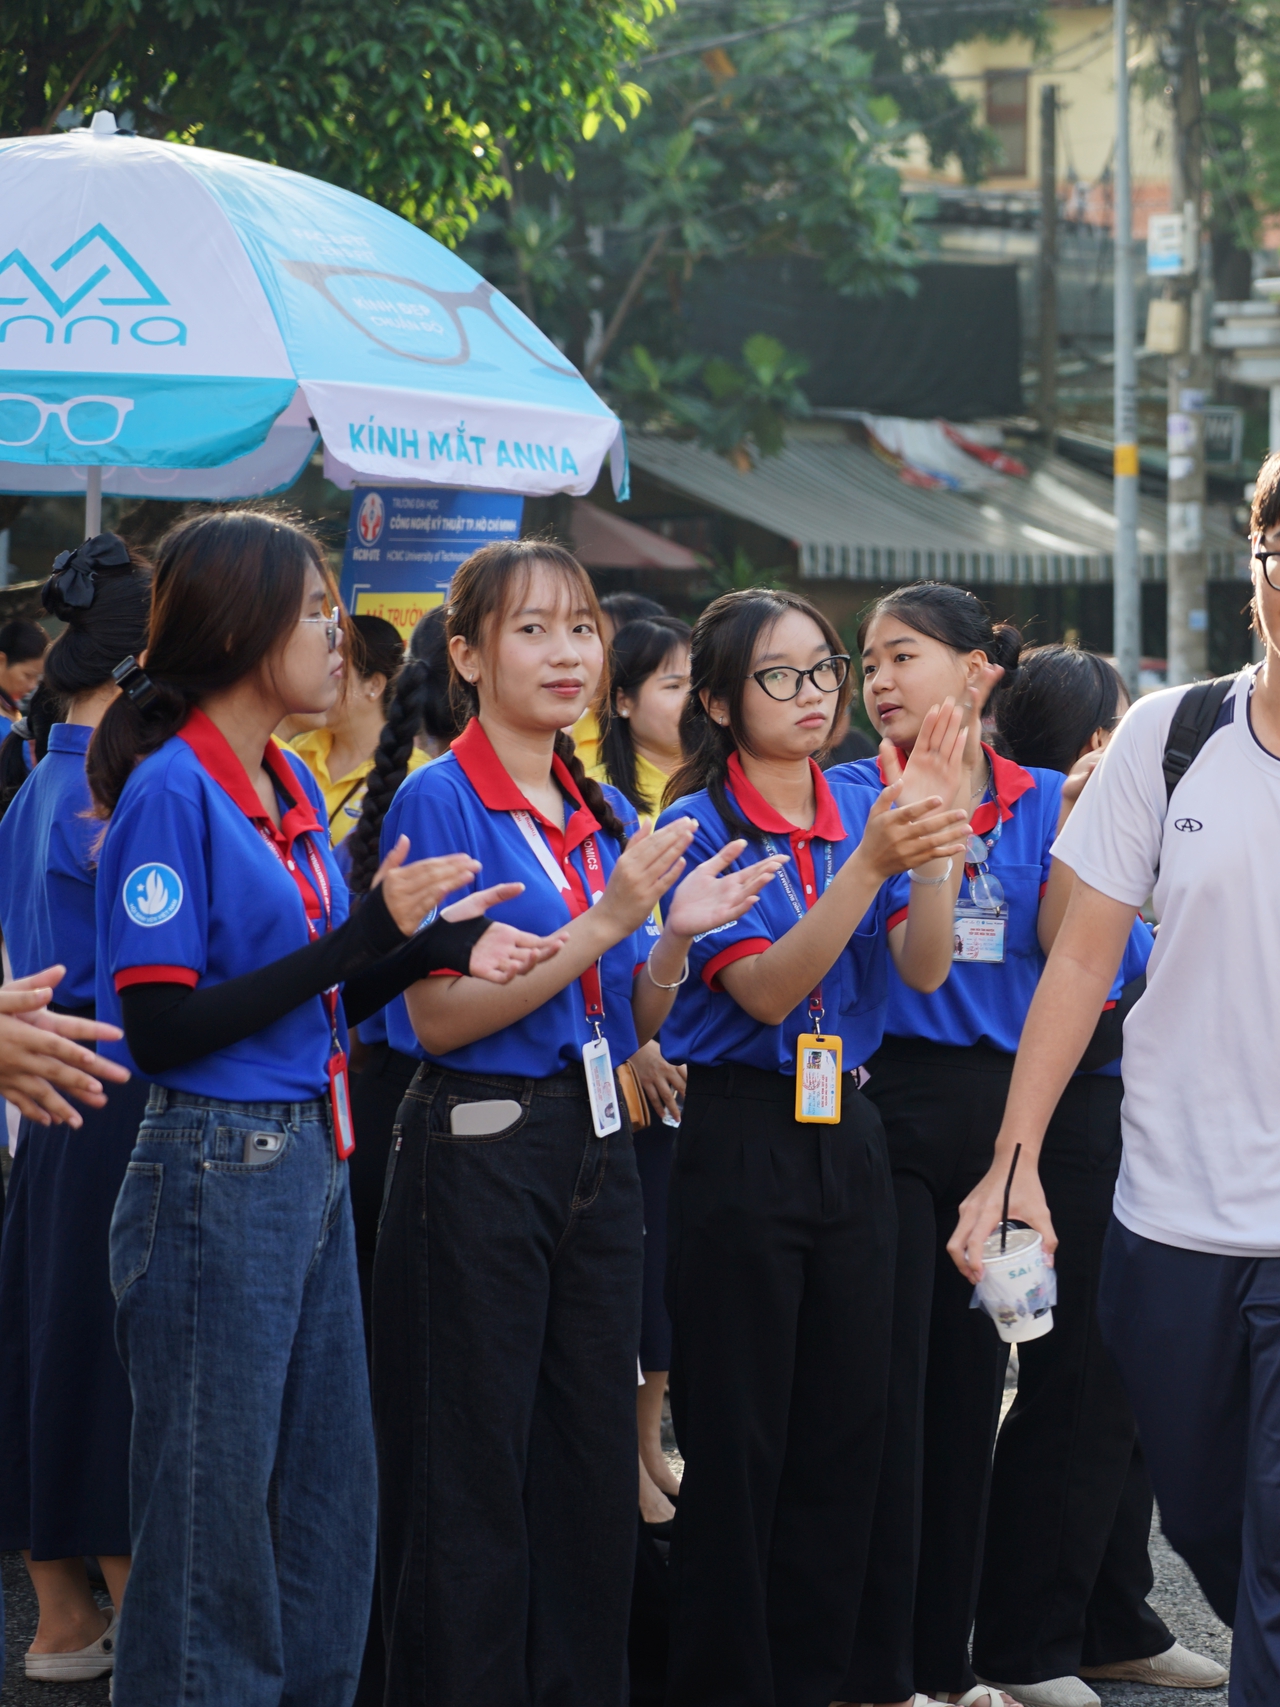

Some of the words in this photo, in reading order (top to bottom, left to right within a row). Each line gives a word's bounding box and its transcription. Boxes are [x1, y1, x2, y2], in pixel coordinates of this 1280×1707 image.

[349, 415, 419, 459] KÍNH
[428, 420, 486, 466] MẮT
[497, 440, 579, 476] ANNA
[389, 513, 410, 530] CÔNG
[410, 514, 431, 533] NGHỆ
[442, 515, 466, 534] THUẬT
[405, 550, 434, 564] University
[387, 602, 432, 627] TRƯỜ
